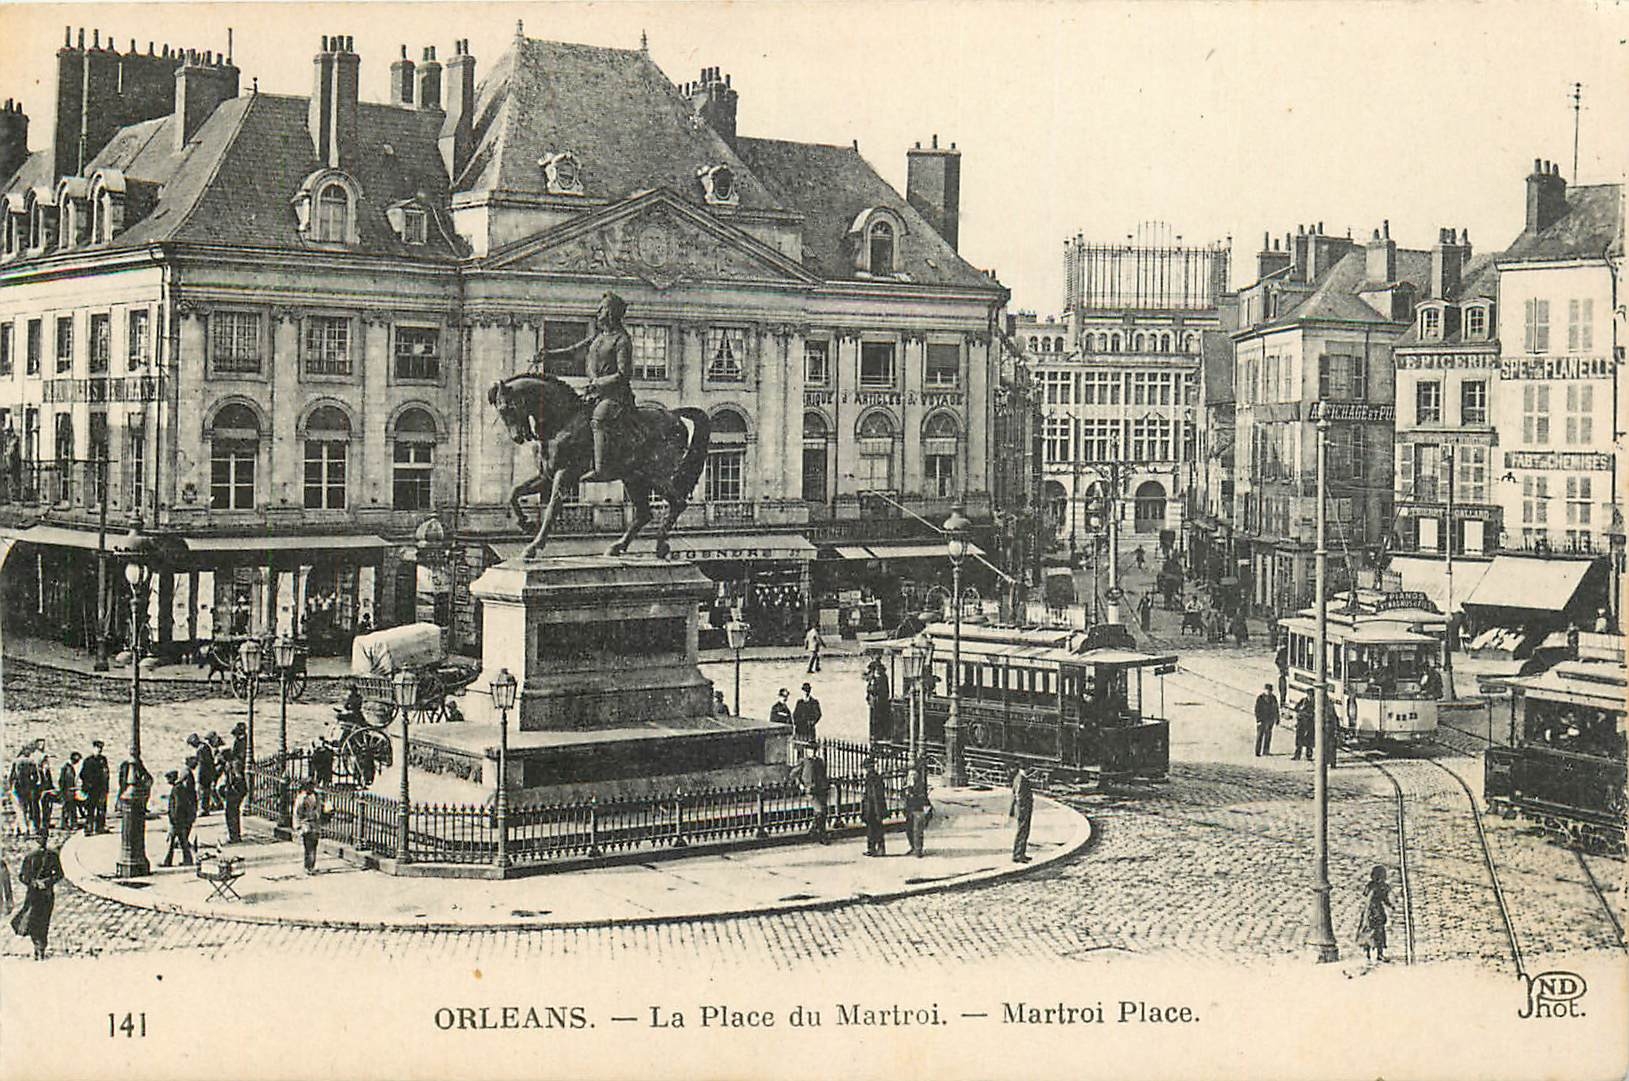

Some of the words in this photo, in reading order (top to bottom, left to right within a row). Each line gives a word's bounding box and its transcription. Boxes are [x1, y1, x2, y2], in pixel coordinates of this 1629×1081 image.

[1406, 354, 1496, 369] EPICERIE
[1544, 358, 1615, 378] FLANELLE
[1310, 403, 1368, 420] AFICHAGE
[668, 549, 772, 560] EGENDRE
